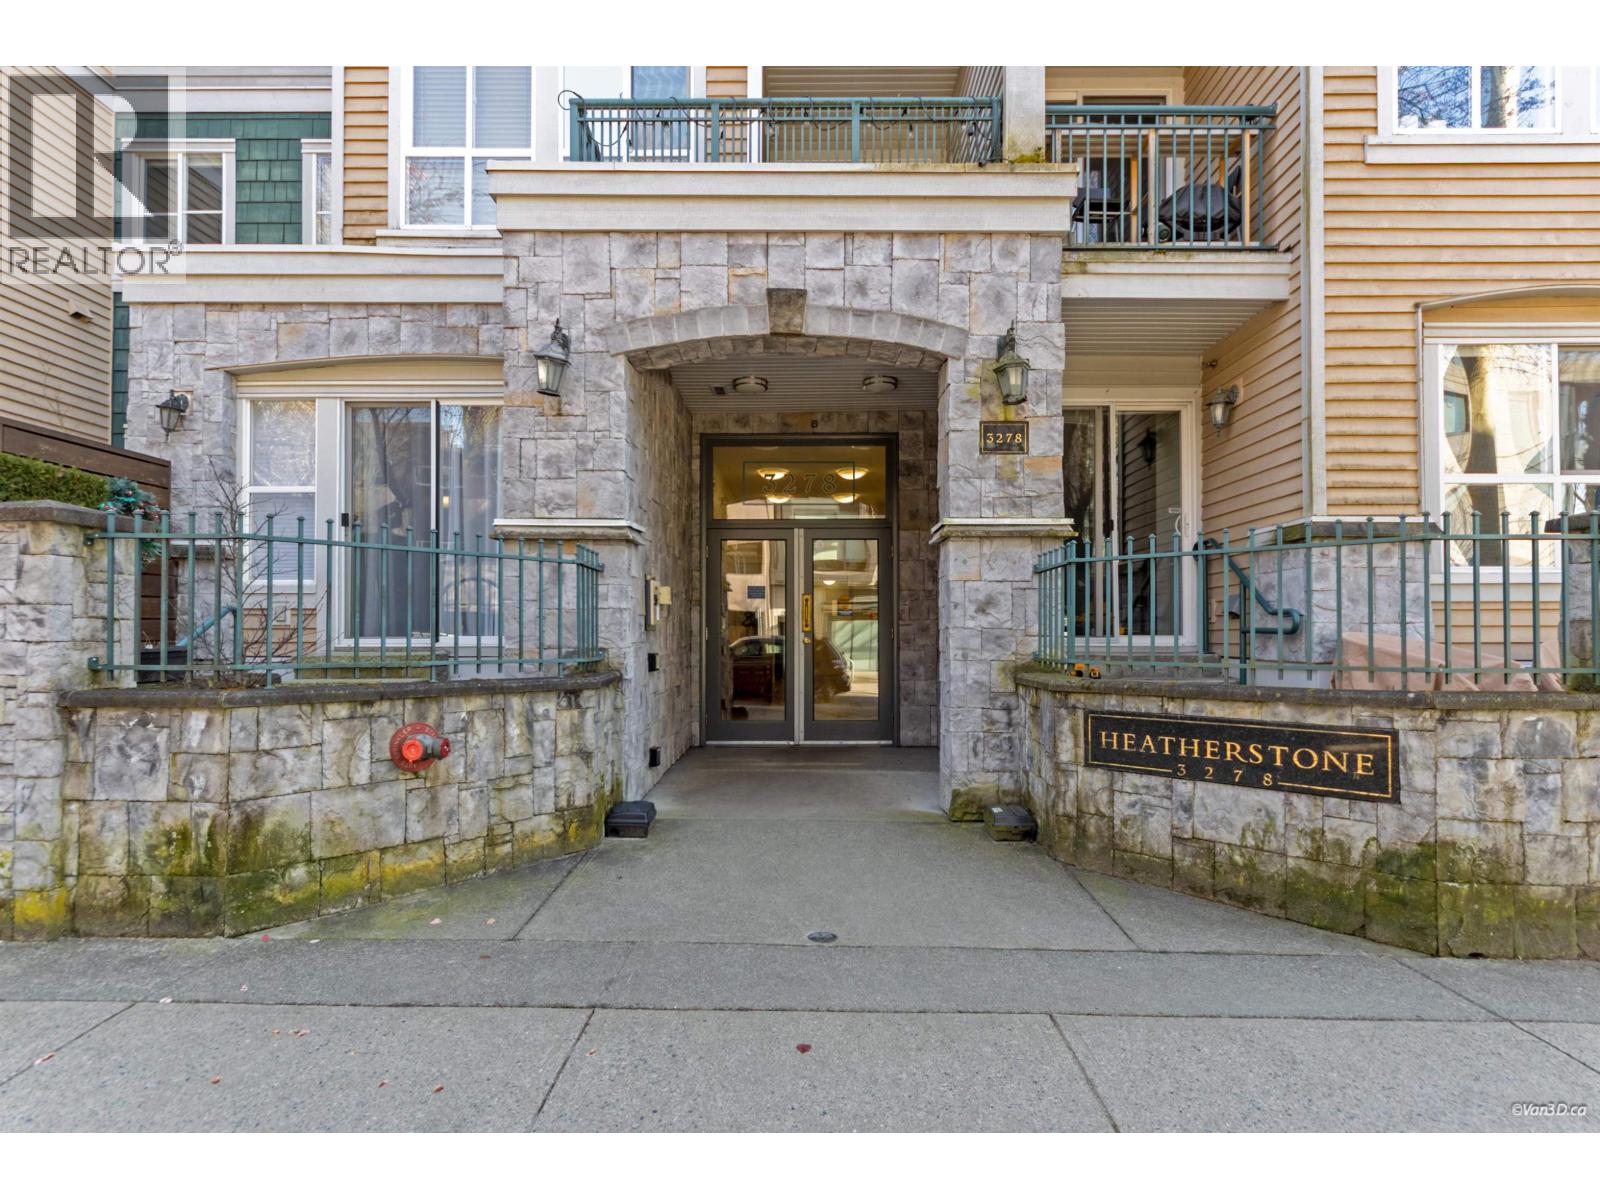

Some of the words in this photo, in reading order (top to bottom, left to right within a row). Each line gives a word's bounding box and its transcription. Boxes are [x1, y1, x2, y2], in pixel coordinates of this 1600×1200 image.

[986, 433, 1022, 443] 3278
[762, 473, 837, 493] 3278
[1099, 731, 1375, 776] HEATHERSTONE
